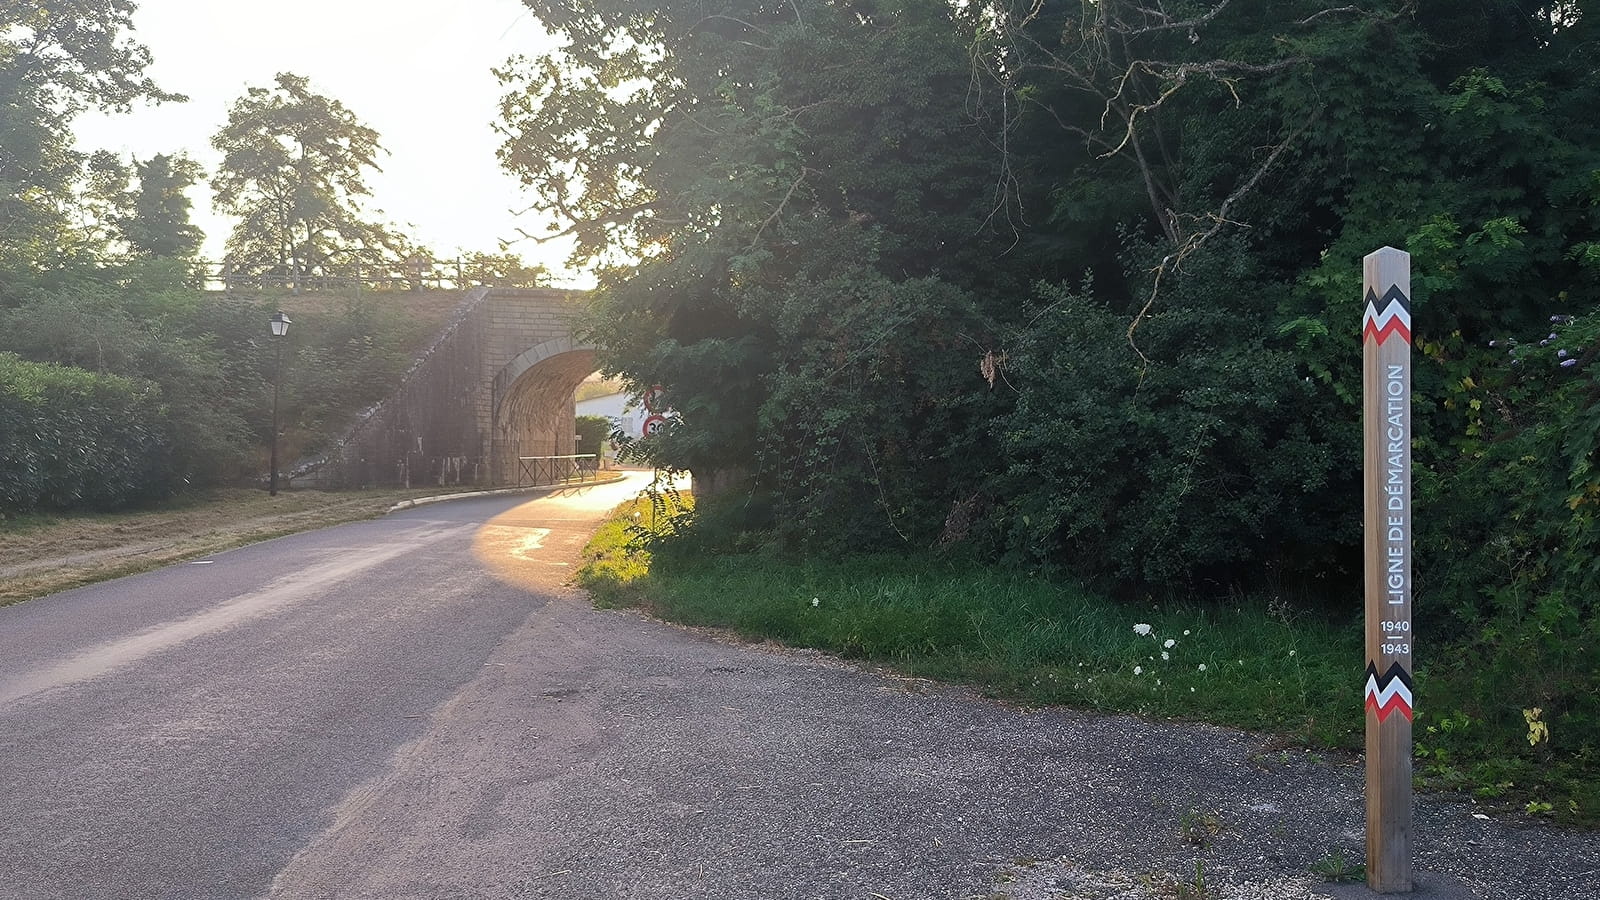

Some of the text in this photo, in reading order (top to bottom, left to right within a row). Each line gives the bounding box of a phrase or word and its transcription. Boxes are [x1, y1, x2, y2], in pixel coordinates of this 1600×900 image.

[1384, 364, 1405, 605] LIGNE DE DÉMARCATION
[1380, 620, 1410, 632] 1940
[1380, 643, 1410, 655] 1943
